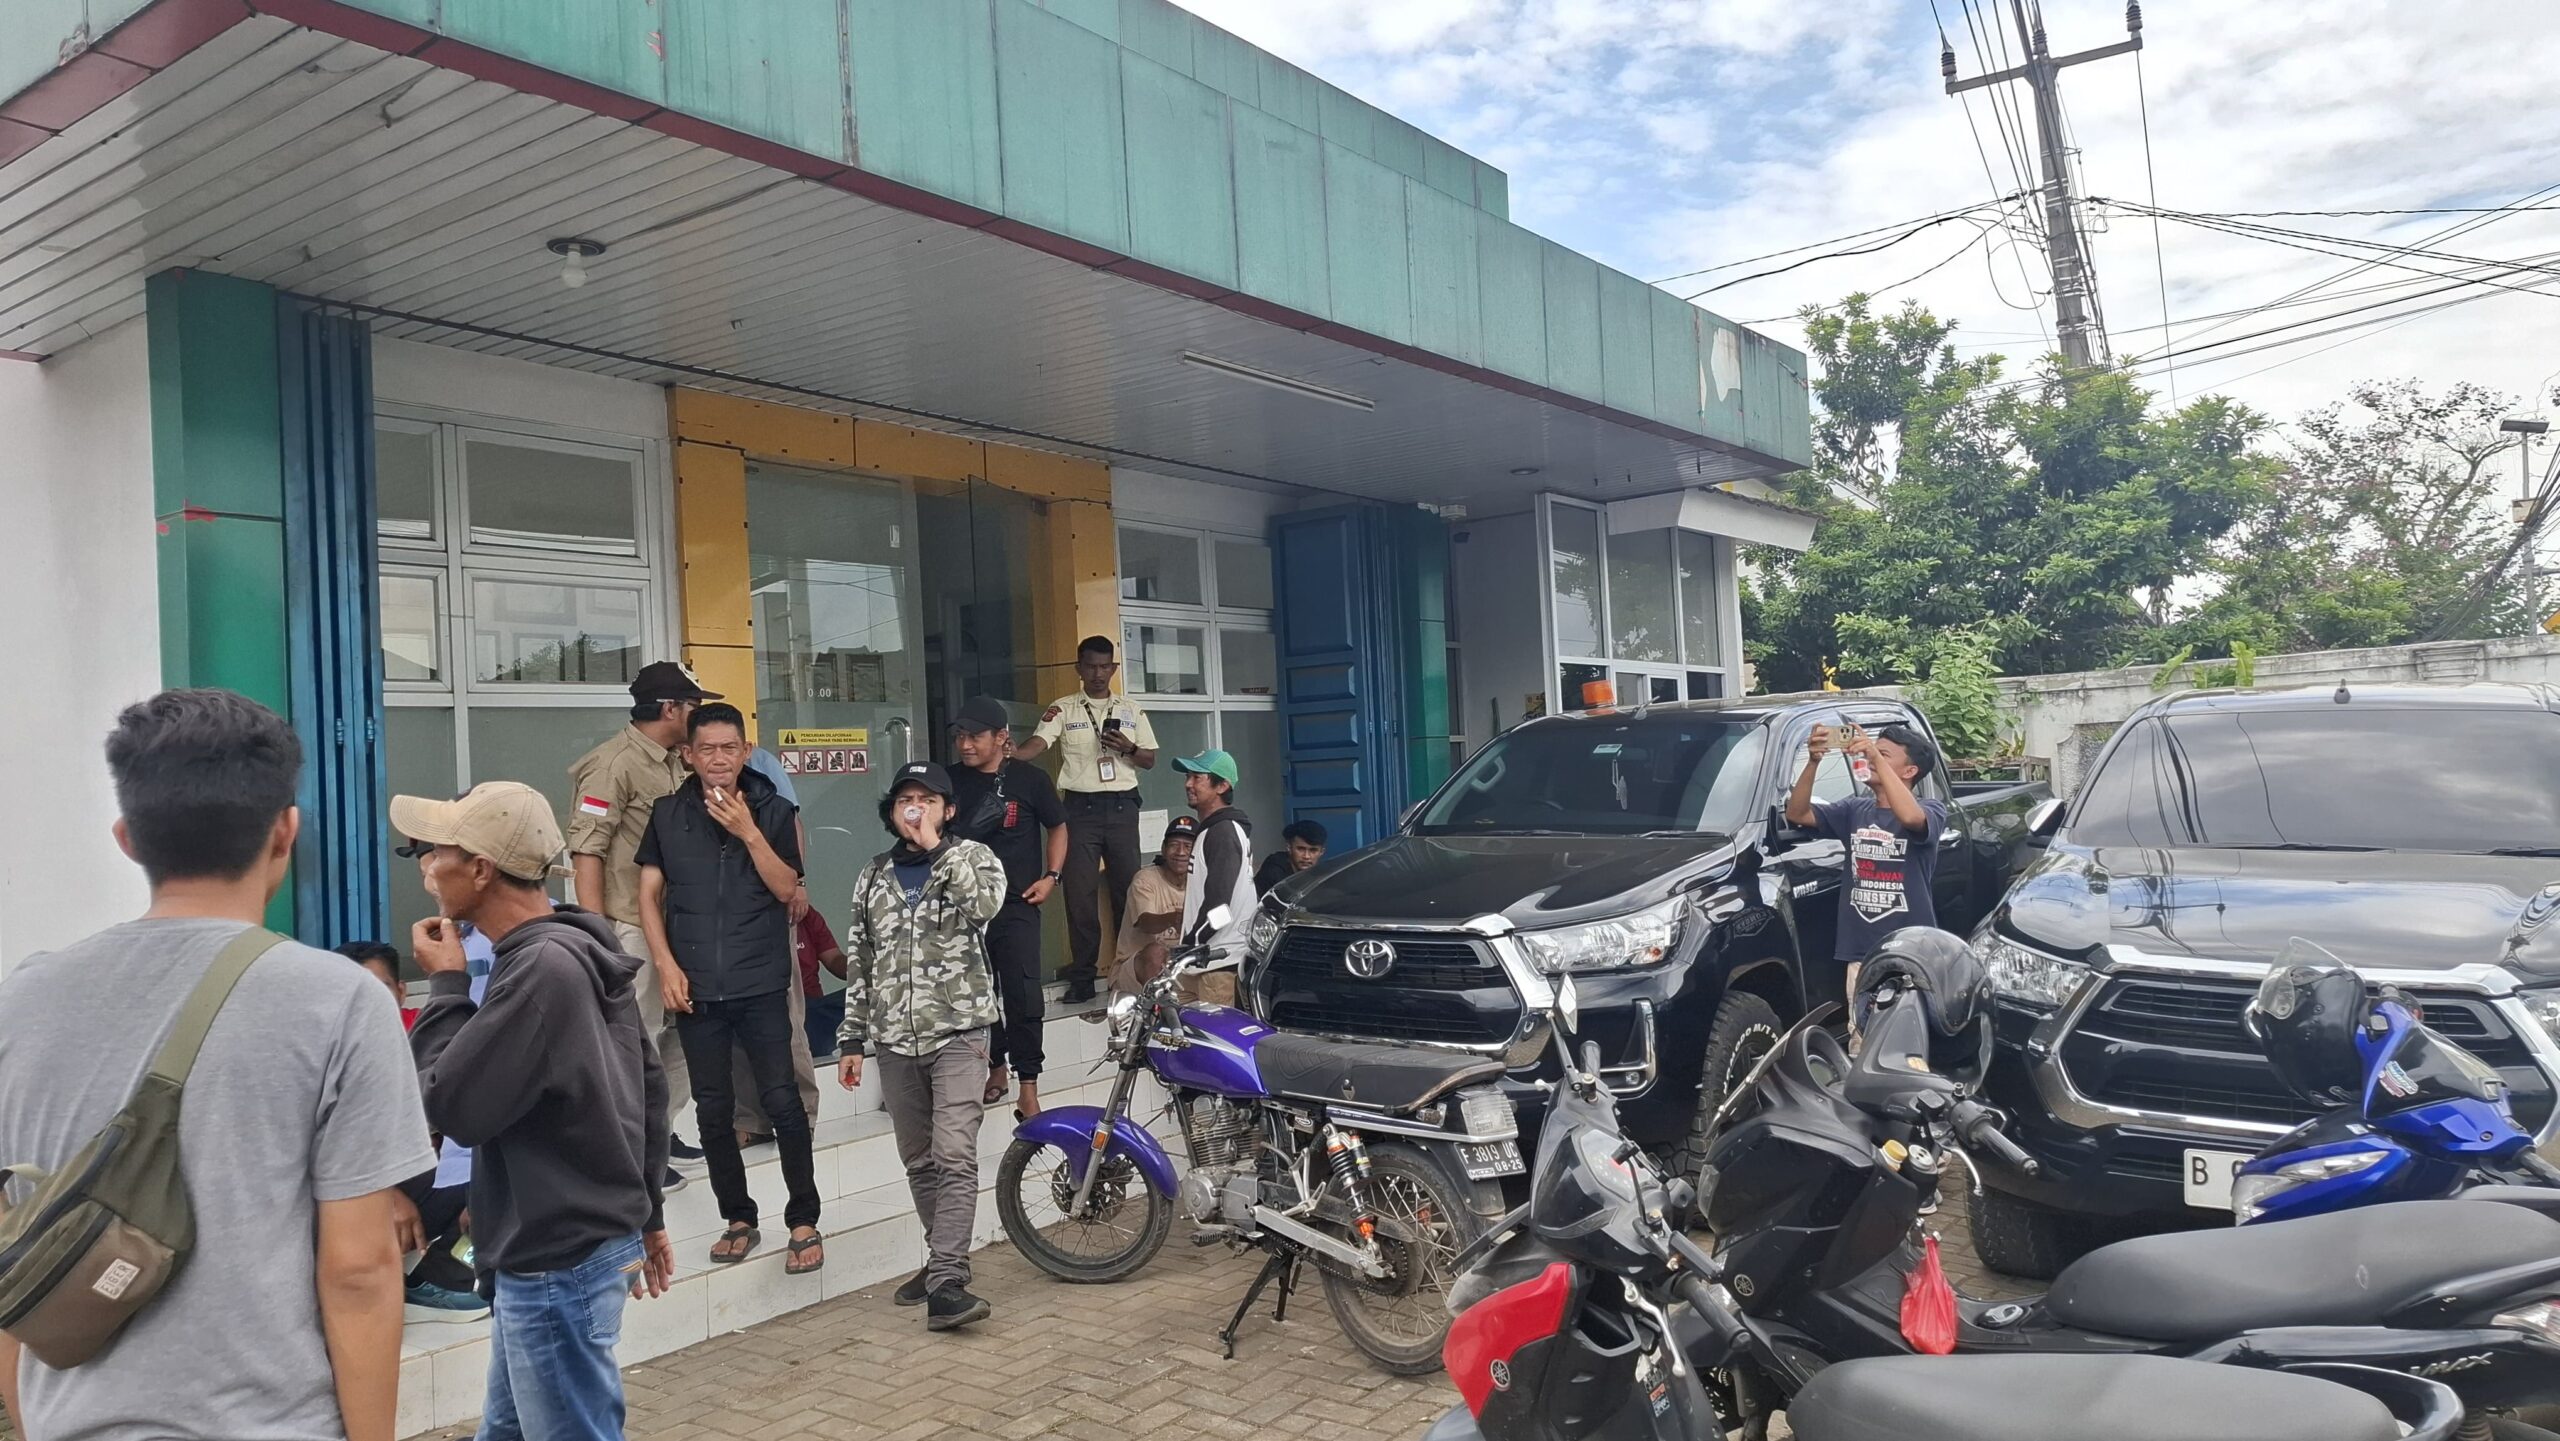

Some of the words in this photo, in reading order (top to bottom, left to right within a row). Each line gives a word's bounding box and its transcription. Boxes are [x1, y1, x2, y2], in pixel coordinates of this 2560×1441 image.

[1860, 880, 1905, 890] INDONESIA
[1460, 1148, 1469, 1164] F
[1472, 1144, 1500, 1162] 3819
[1502, 1141, 1518, 1159] UC
[2192, 1156, 2209, 1185] B
